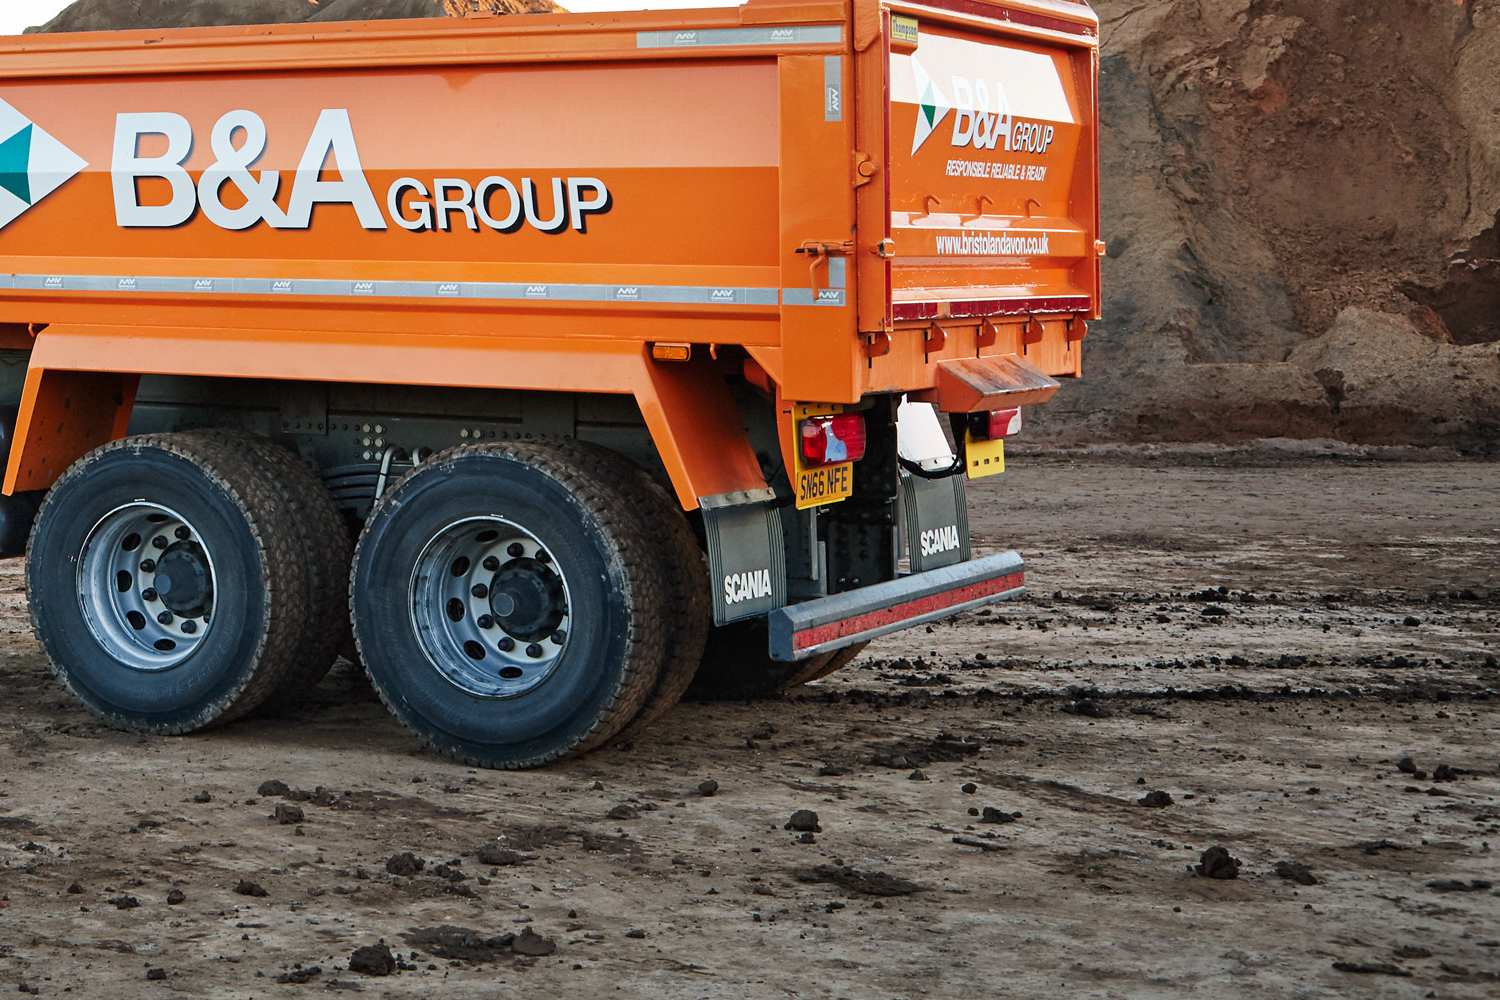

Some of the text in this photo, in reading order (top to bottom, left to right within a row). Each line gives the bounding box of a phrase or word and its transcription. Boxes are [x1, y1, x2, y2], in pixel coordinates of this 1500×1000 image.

[893, 16, 917, 39] Thompson
[951, 74, 1054, 154] B&A GROUP
[111, 108, 611, 233] B&A GROUP
[945, 160, 1047, 181] RESPONSIBLE RELIABLE & READY
[936, 231, 1050, 255] www.bristolandavon.co.uk
[801, 466, 848, 500] SN66 NFE
[920, 524, 960, 557] SCANIA
[724, 569, 773, 605] SCANIA
